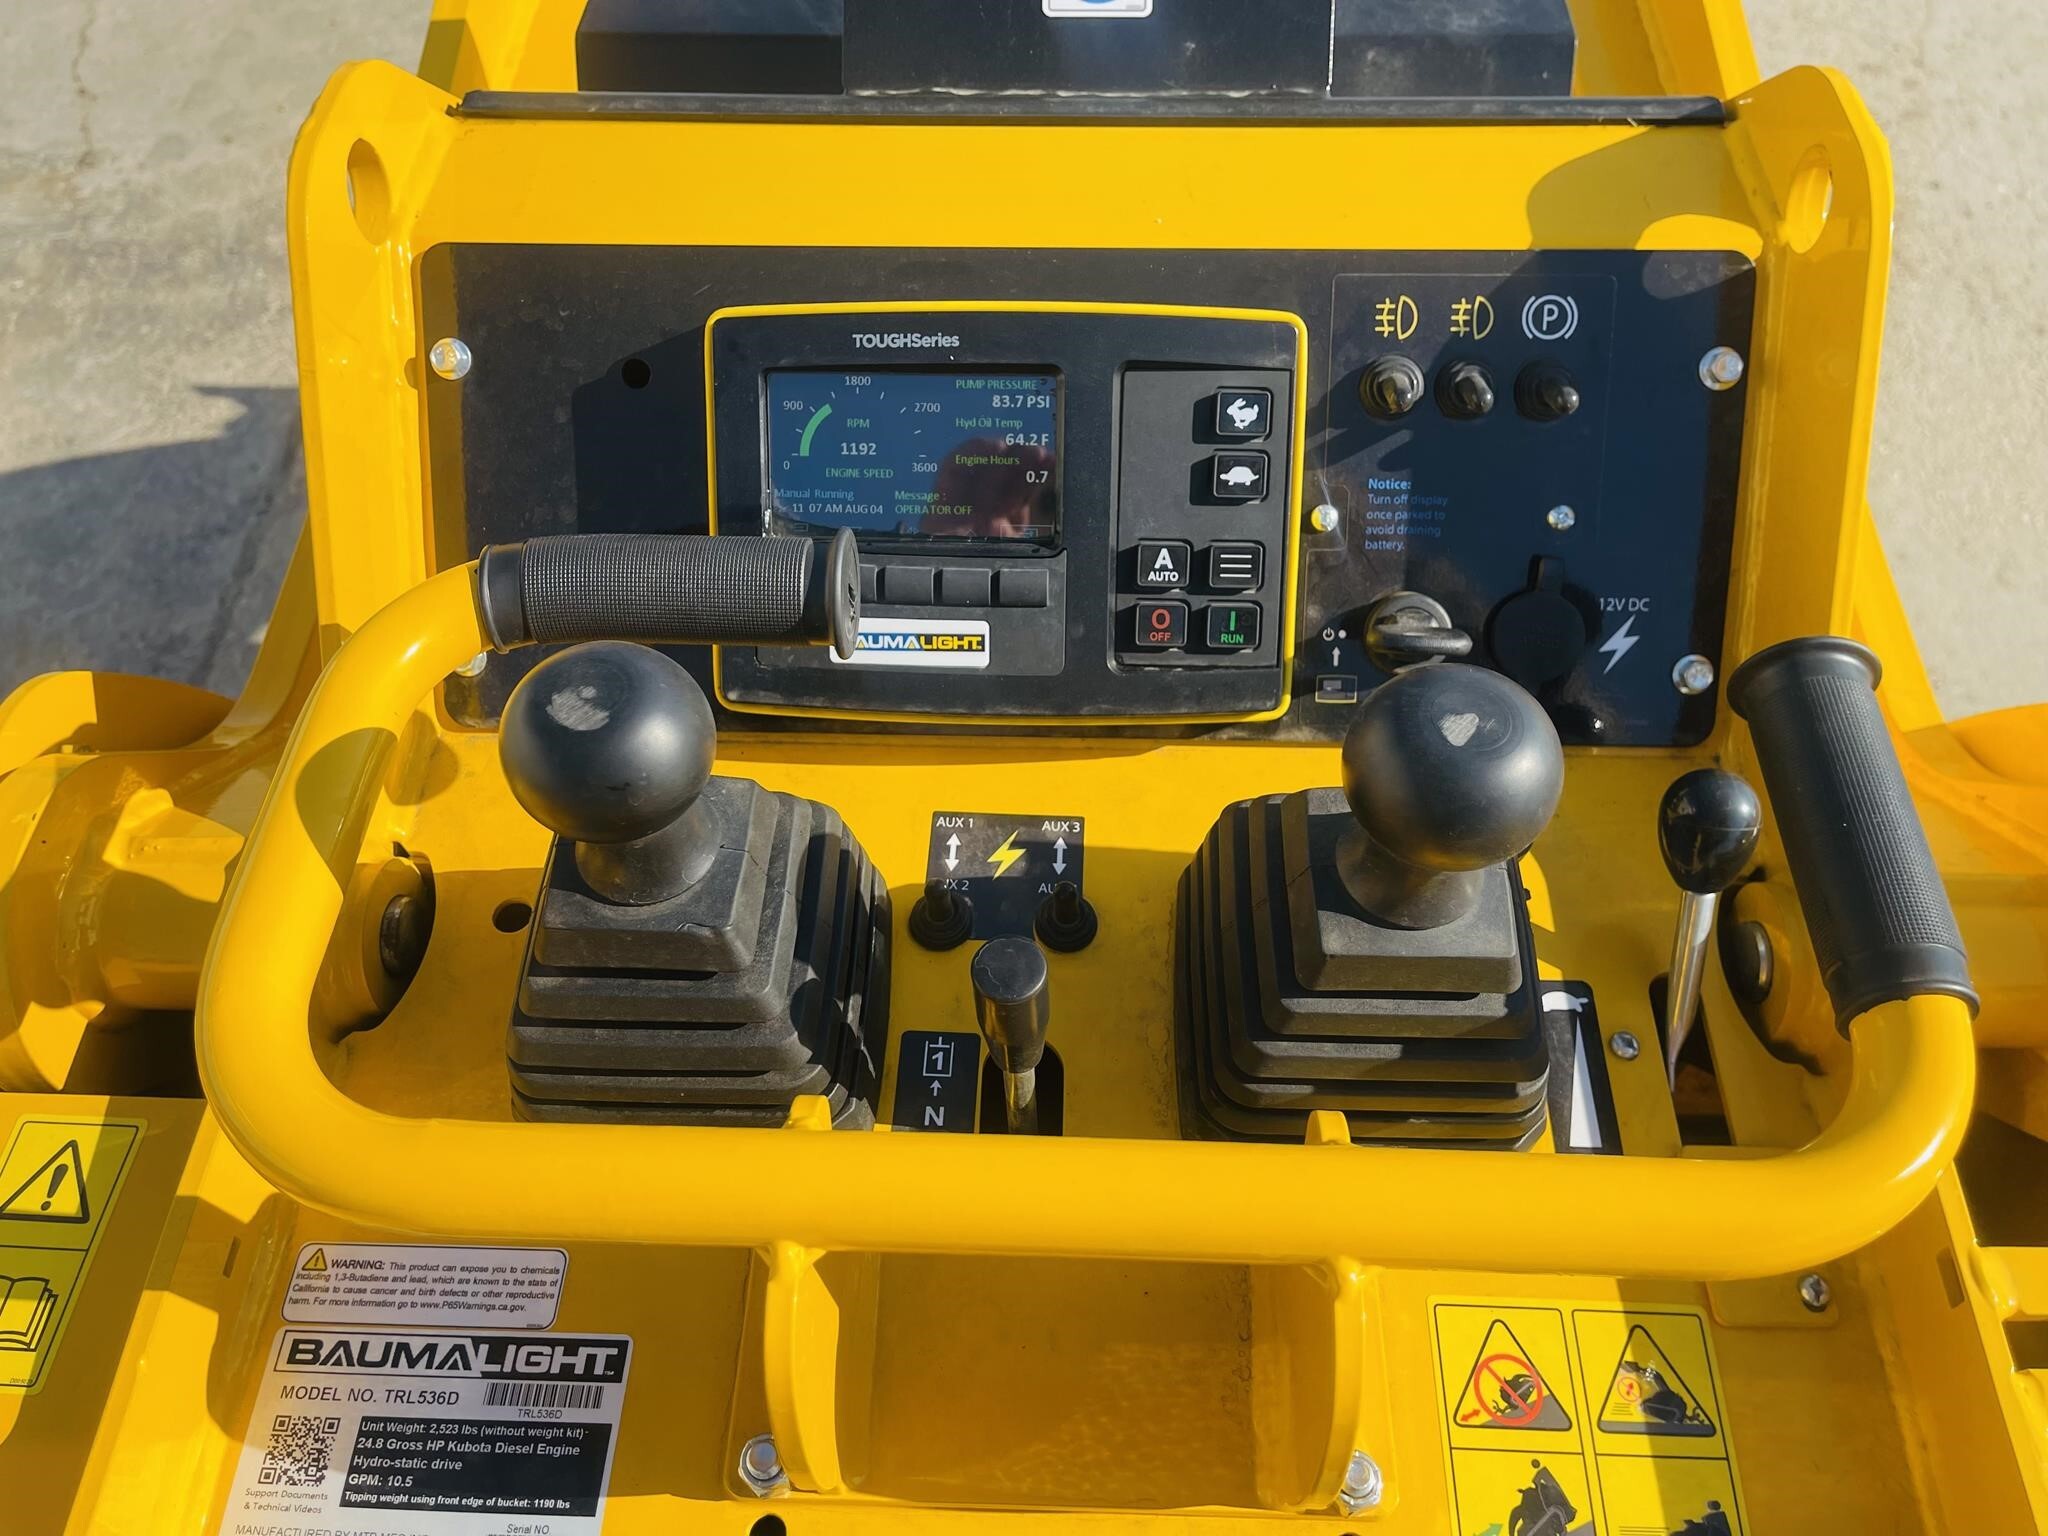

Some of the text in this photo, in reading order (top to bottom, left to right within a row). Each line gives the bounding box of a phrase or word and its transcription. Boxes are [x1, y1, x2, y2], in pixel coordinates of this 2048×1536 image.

[852, 332, 960, 349] TOUGHSeries
[845, 376, 871, 386] 1800
[955, 379, 1038, 390] PUMP PRESSURE
[783, 401, 804, 411] 900
[914, 403, 941, 413] 2700
[992, 395, 1050, 409] 83.7 PSI
[847, 418, 870, 428] RPM
[955, 417, 1023, 430] Hyd Oil Temp
[1005, 434, 1049, 446] 64.2 F
[840, 443, 877, 455] 1192
[783, 460, 790, 470] 0
[955, 455, 1020, 467] Engine Hours
[825, 467, 894, 478] ENGINE SPEED
[912, 463, 938, 473] 3600
[1026, 471, 1049, 484] 0.7
[1368, 478, 1412, 490] Notice:
[774, 488, 855, 501] Manual Running
[895, 490, 940, 503] Message
[1367, 493, 1448, 506] Turn off display
[824, 504, 843, 513] AM
[844, 504, 868, 514] AUG
[869, 505, 883, 514] 04
[895, 504, 974, 515] OPERATOR OFF
[1366, 510, 1446, 522] once parked to
[1365, 524, 1441, 537] avoid draining
[1365, 540, 1405, 552] battery.
[1148, 571, 1179, 583] AUTO
[1599, 598, 1650, 612] 12V DC
[855, 634, 982, 650] AUMALIGHT
[1150, 631, 1172, 642] OFF
[1220, 633, 1244, 644] RUN
[936, 816, 974, 828] AUX 1
[1041, 821, 1081, 833] AUX 3
[961, 879, 969, 891] 2
[924, 1106, 945, 1127] N
[331, 1259, 386, 1270] WARNING:
[389, 1262, 406, 1271] This
[409, 1262, 440, 1272] product
[460, 1265, 489, 1274] expose
[491, 1266, 507, 1275] you
[509, 1265, 518, 1274] to
[520, 1266, 560, 1275] chemicals
[296, 1272, 559, 1287] including 1,3-Butadiene and lead, which are known to the state of
[292, 1283, 555, 1300] California to cause cancer and birth defects or other reproductive
[288, 1297, 311, 1305] harm.
[312, 1297, 327, 1306] For
[351, 1298, 396, 1308] information
[397, 1301, 409, 1310] go
[410, 1300, 418, 1308] to
[286, 1338, 619, 1376] BAUMALIGHT
[280, 1385, 460, 1406] MODEL NO. TRL536D
[517, 1408, 563, 1419] TRL536D
[361, 1421, 385, 1432] Unit
[386, 1422, 427, 1435] Weight:
[429, 1423, 459, 1435] 2,523
[461, 1424, 478, 1435] lbs
[480, 1425, 525, 1437] (without
[527, 1427, 564, 1439] weight
[357, 1437, 581, 1458] 24.8 Gross HP Kubota Diesel Engine
[353, 1455, 463, 1470] Hydro-static drive
[348, 1473, 414, 1487] GPM: 10.5
[245, 1487, 329, 1501] Support Documents
[344, 1491, 571, 1509] Tipping weight using front edge of bucket: 1190 lbs
[243, 1501, 322, 1514] & Technical Videos
[506, 1523, 532, 1535] Serial
